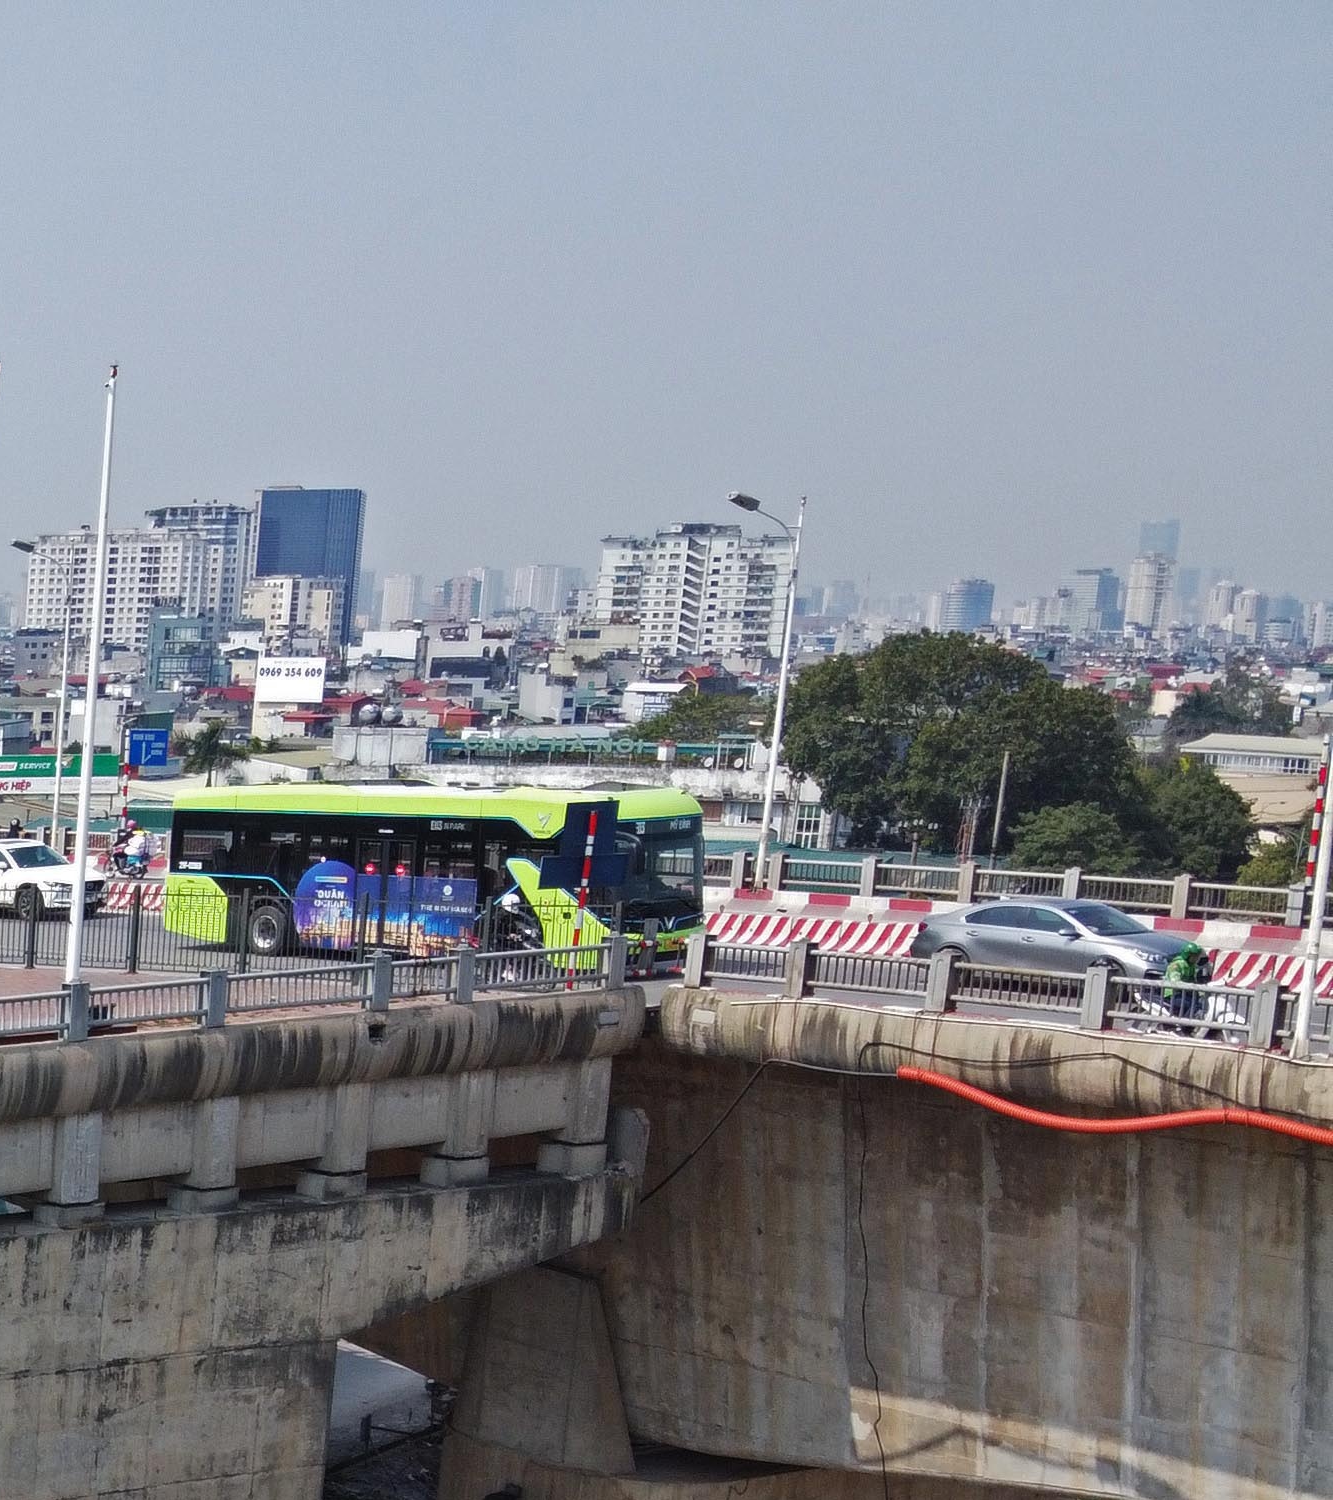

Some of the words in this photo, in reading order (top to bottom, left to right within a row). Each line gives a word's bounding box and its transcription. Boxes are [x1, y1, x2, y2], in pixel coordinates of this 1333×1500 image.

[259, 667, 282, 677] 0969
[284, 667, 302, 677] 354
[304, 667, 323, 677] 609
[19, 762, 52, 770] SERVICE
[10, 777, 32, 792] HIỆP
